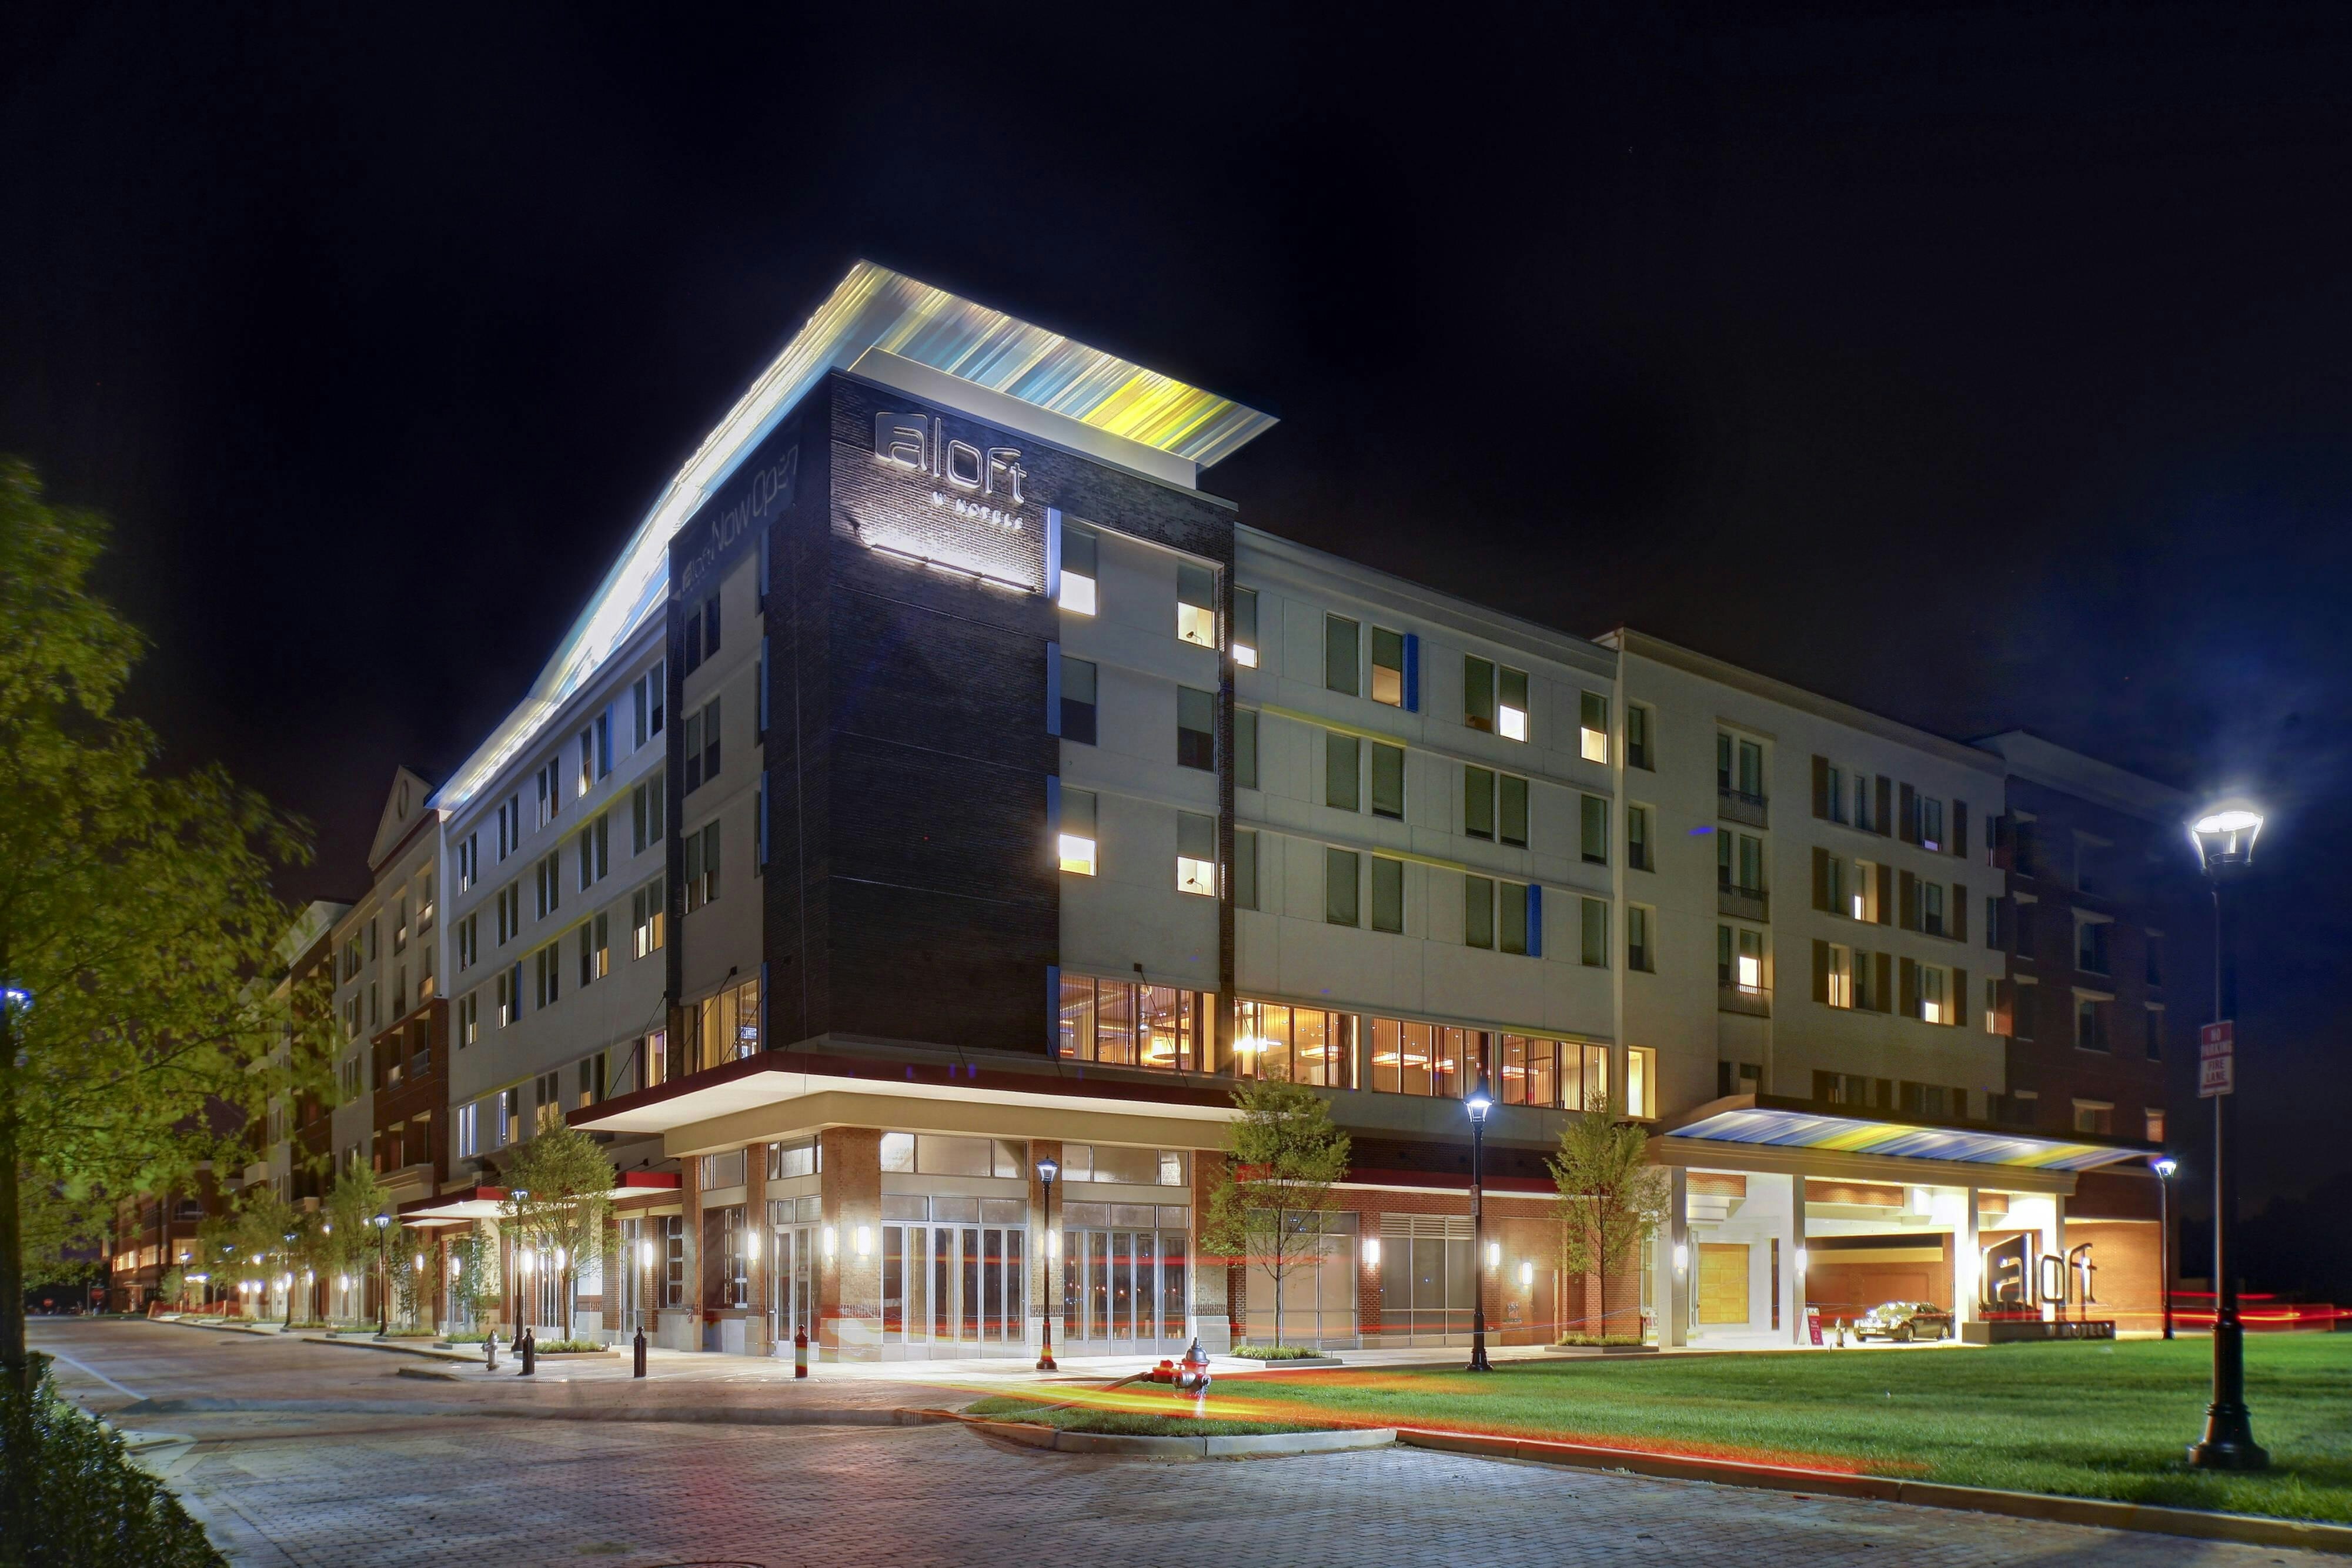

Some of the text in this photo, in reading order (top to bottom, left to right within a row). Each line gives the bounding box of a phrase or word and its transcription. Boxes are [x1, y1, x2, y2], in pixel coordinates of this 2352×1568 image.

[876, 412, 1028, 504] aloft
[2206, 1071, 2226, 1082] LANE
[2207, 1059, 2225, 1070] FIRE
[1982, 1232, 2097, 1307] aloft
